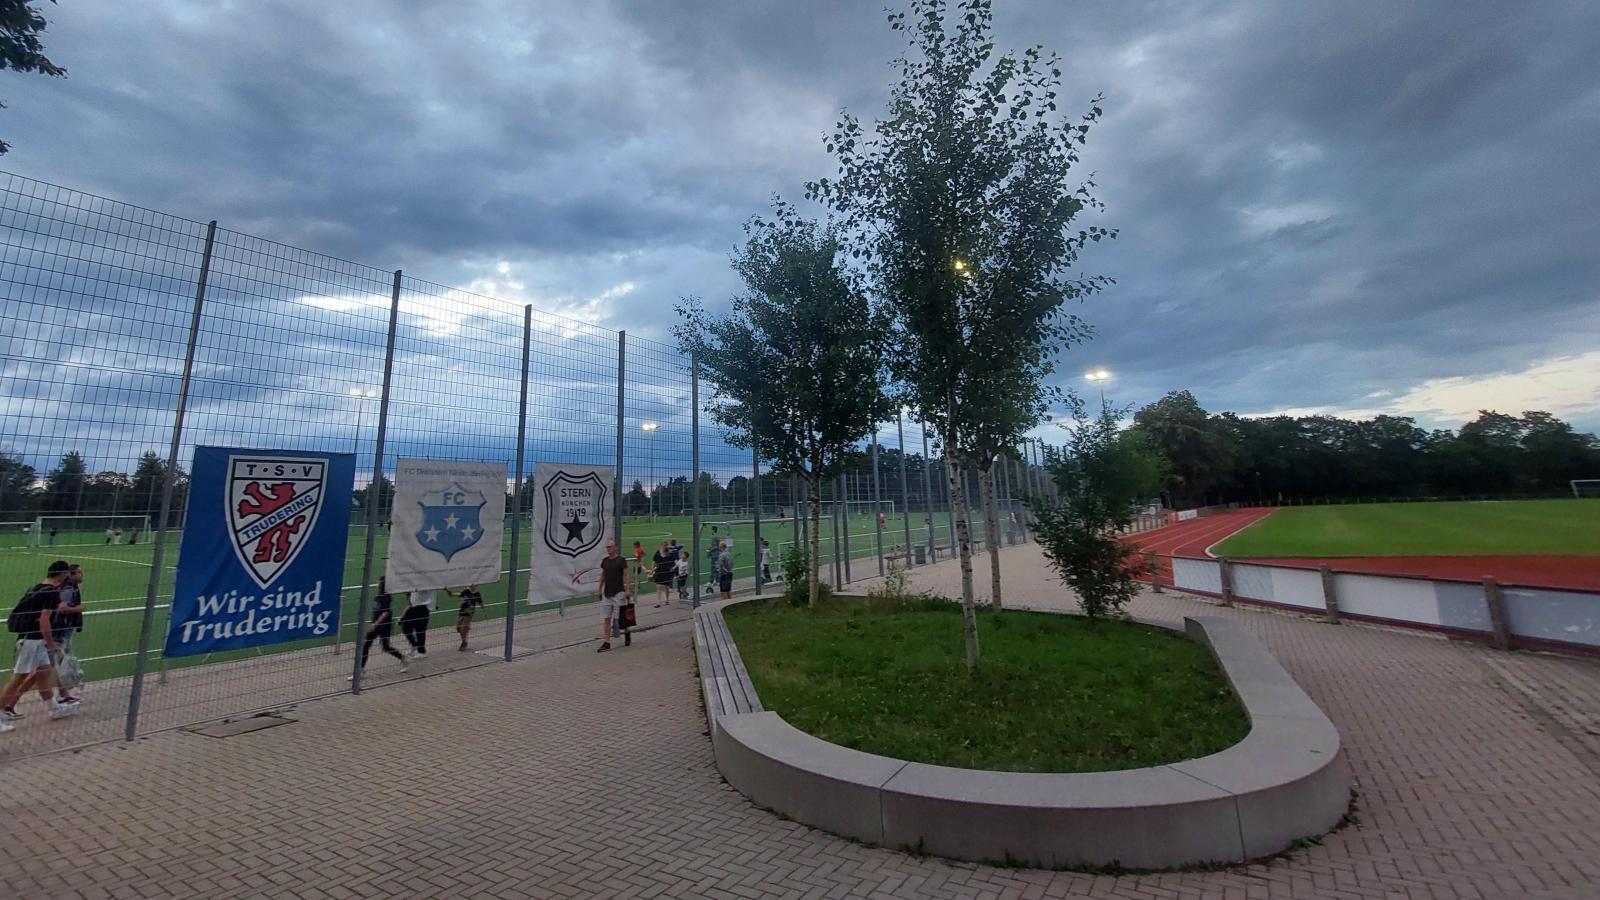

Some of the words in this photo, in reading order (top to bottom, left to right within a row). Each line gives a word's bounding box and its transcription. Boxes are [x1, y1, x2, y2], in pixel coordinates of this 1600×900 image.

[442, 492, 465, 505] FC
[560, 488, 591, 498] STERN
[242, 494, 314, 541] TRUDERING
[196, 590, 255, 617] Wir
[260, 580, 322, 610] sind
[180, 607, 333, 644] Trudering
